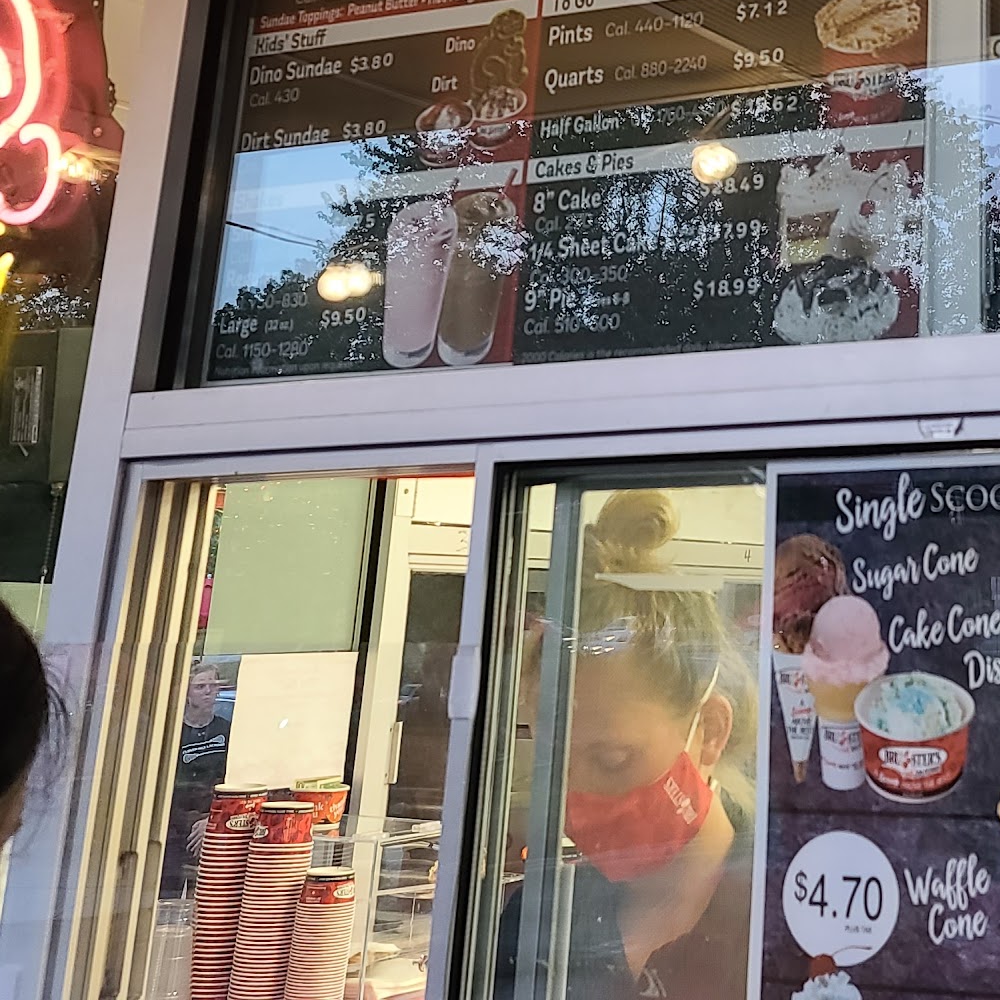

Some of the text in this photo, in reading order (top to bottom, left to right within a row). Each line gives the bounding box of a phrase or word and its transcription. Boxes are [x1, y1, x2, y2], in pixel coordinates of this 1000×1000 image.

[260, 14, 296, 28] Sundae
[299, 7, 343, 27] Toppings:
[348, 0, 382, 16] Peanut
[548, 1, 789, 47] Pints Cal. 440-1120 $7.12
[255, 28, 328, 54] Kids' Stuff
[445, 36, 476, 54] Dino
[250, 52, 394, 86] Dino Sundae $3.80
[544, 47, 785, 94] Quarts Cal. 880-2240 $9.50
[274, 87, 300, 104] 430
[431, 76, 459, 93] Dirt
[241, 119, 387, 152] Dirt Sundae $3.80
[539, 118, 570, 139] Half
[573, 113, 620, 134] Gallon
[535, 152, 634, 179] Cakes & Pies
[533, 190, 555, 214] 8"
[557, 188, 601, 211] Cake
[529, 233, 608, 262] 1/4 Sheet
[693, 278, 760, 301] $18.99
[220, 307, 367, 339] Large $9.50
[524, 318, 549, 335] Cal.
[216, 344, 239, 360] Cal.
[835, 472, 926, 541] Single
[852, 542, 980, 600] Sugar Cone
[888, 609, 945, 653] Cake
[794, 870, 883, 921] $4.70
[904, 853, 991, 912] Waffle
[928, 904, 990, 945] Cone
